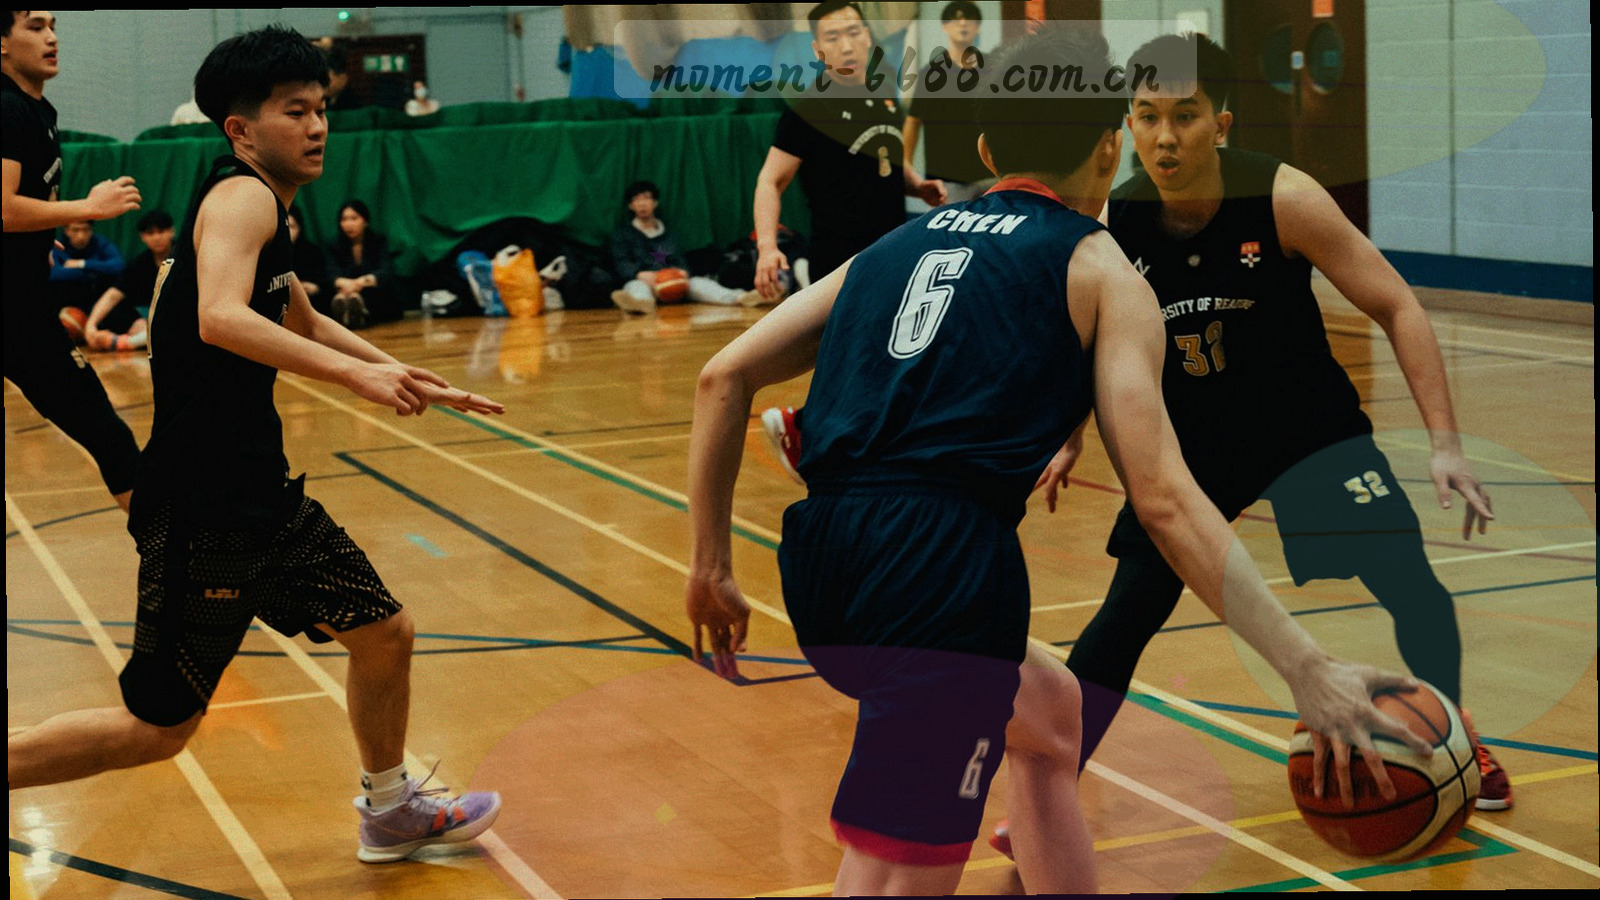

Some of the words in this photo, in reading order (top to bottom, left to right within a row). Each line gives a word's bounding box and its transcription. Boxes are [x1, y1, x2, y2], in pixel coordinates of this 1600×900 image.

[927, 208, 1028, 235] CHEN
[887, 246, 974, 360] 6
[1160, 299, 1196, 322] RSITY
[1197, 296, 1212, 312] OF
[1343, 470, 1390, 504] 32
[958, 738, 990, 799] 6
